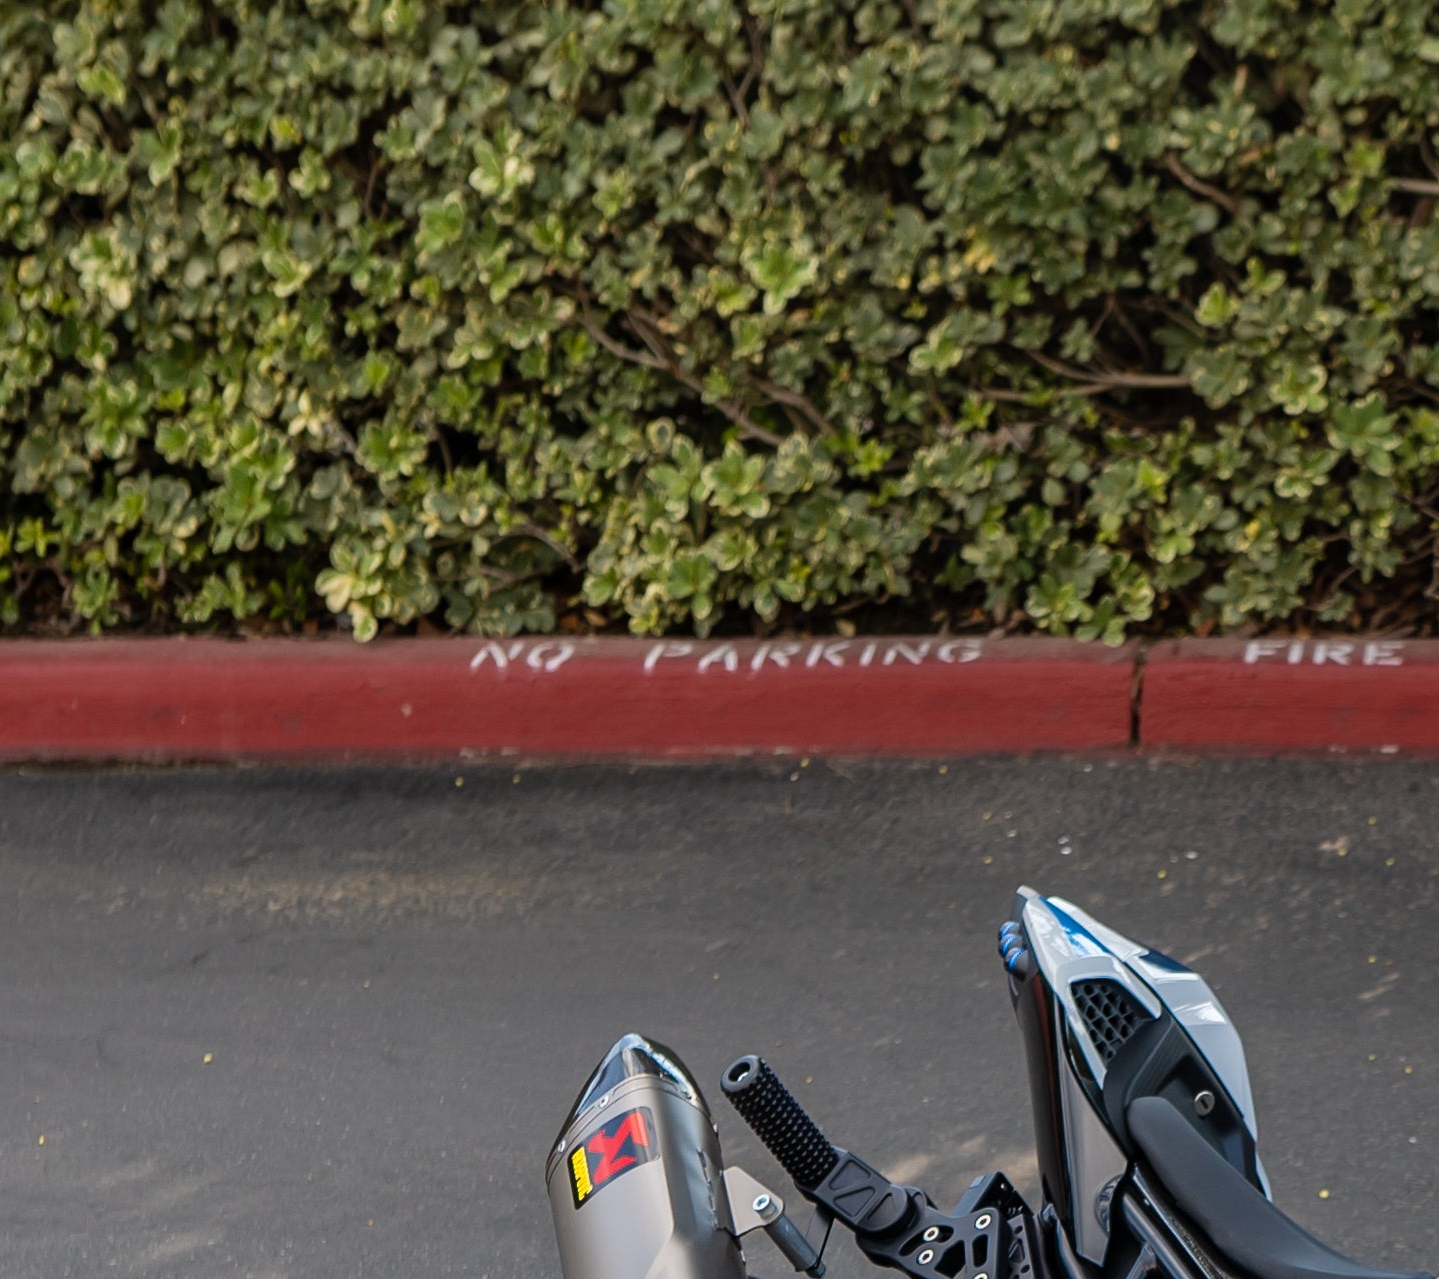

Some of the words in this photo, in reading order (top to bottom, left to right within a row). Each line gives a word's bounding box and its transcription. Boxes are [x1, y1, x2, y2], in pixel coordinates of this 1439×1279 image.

[470, 641, 575, 673] NO
[643, 637, 983, 674] PARKING
[1243, 639, 1406, 665] FIRE
